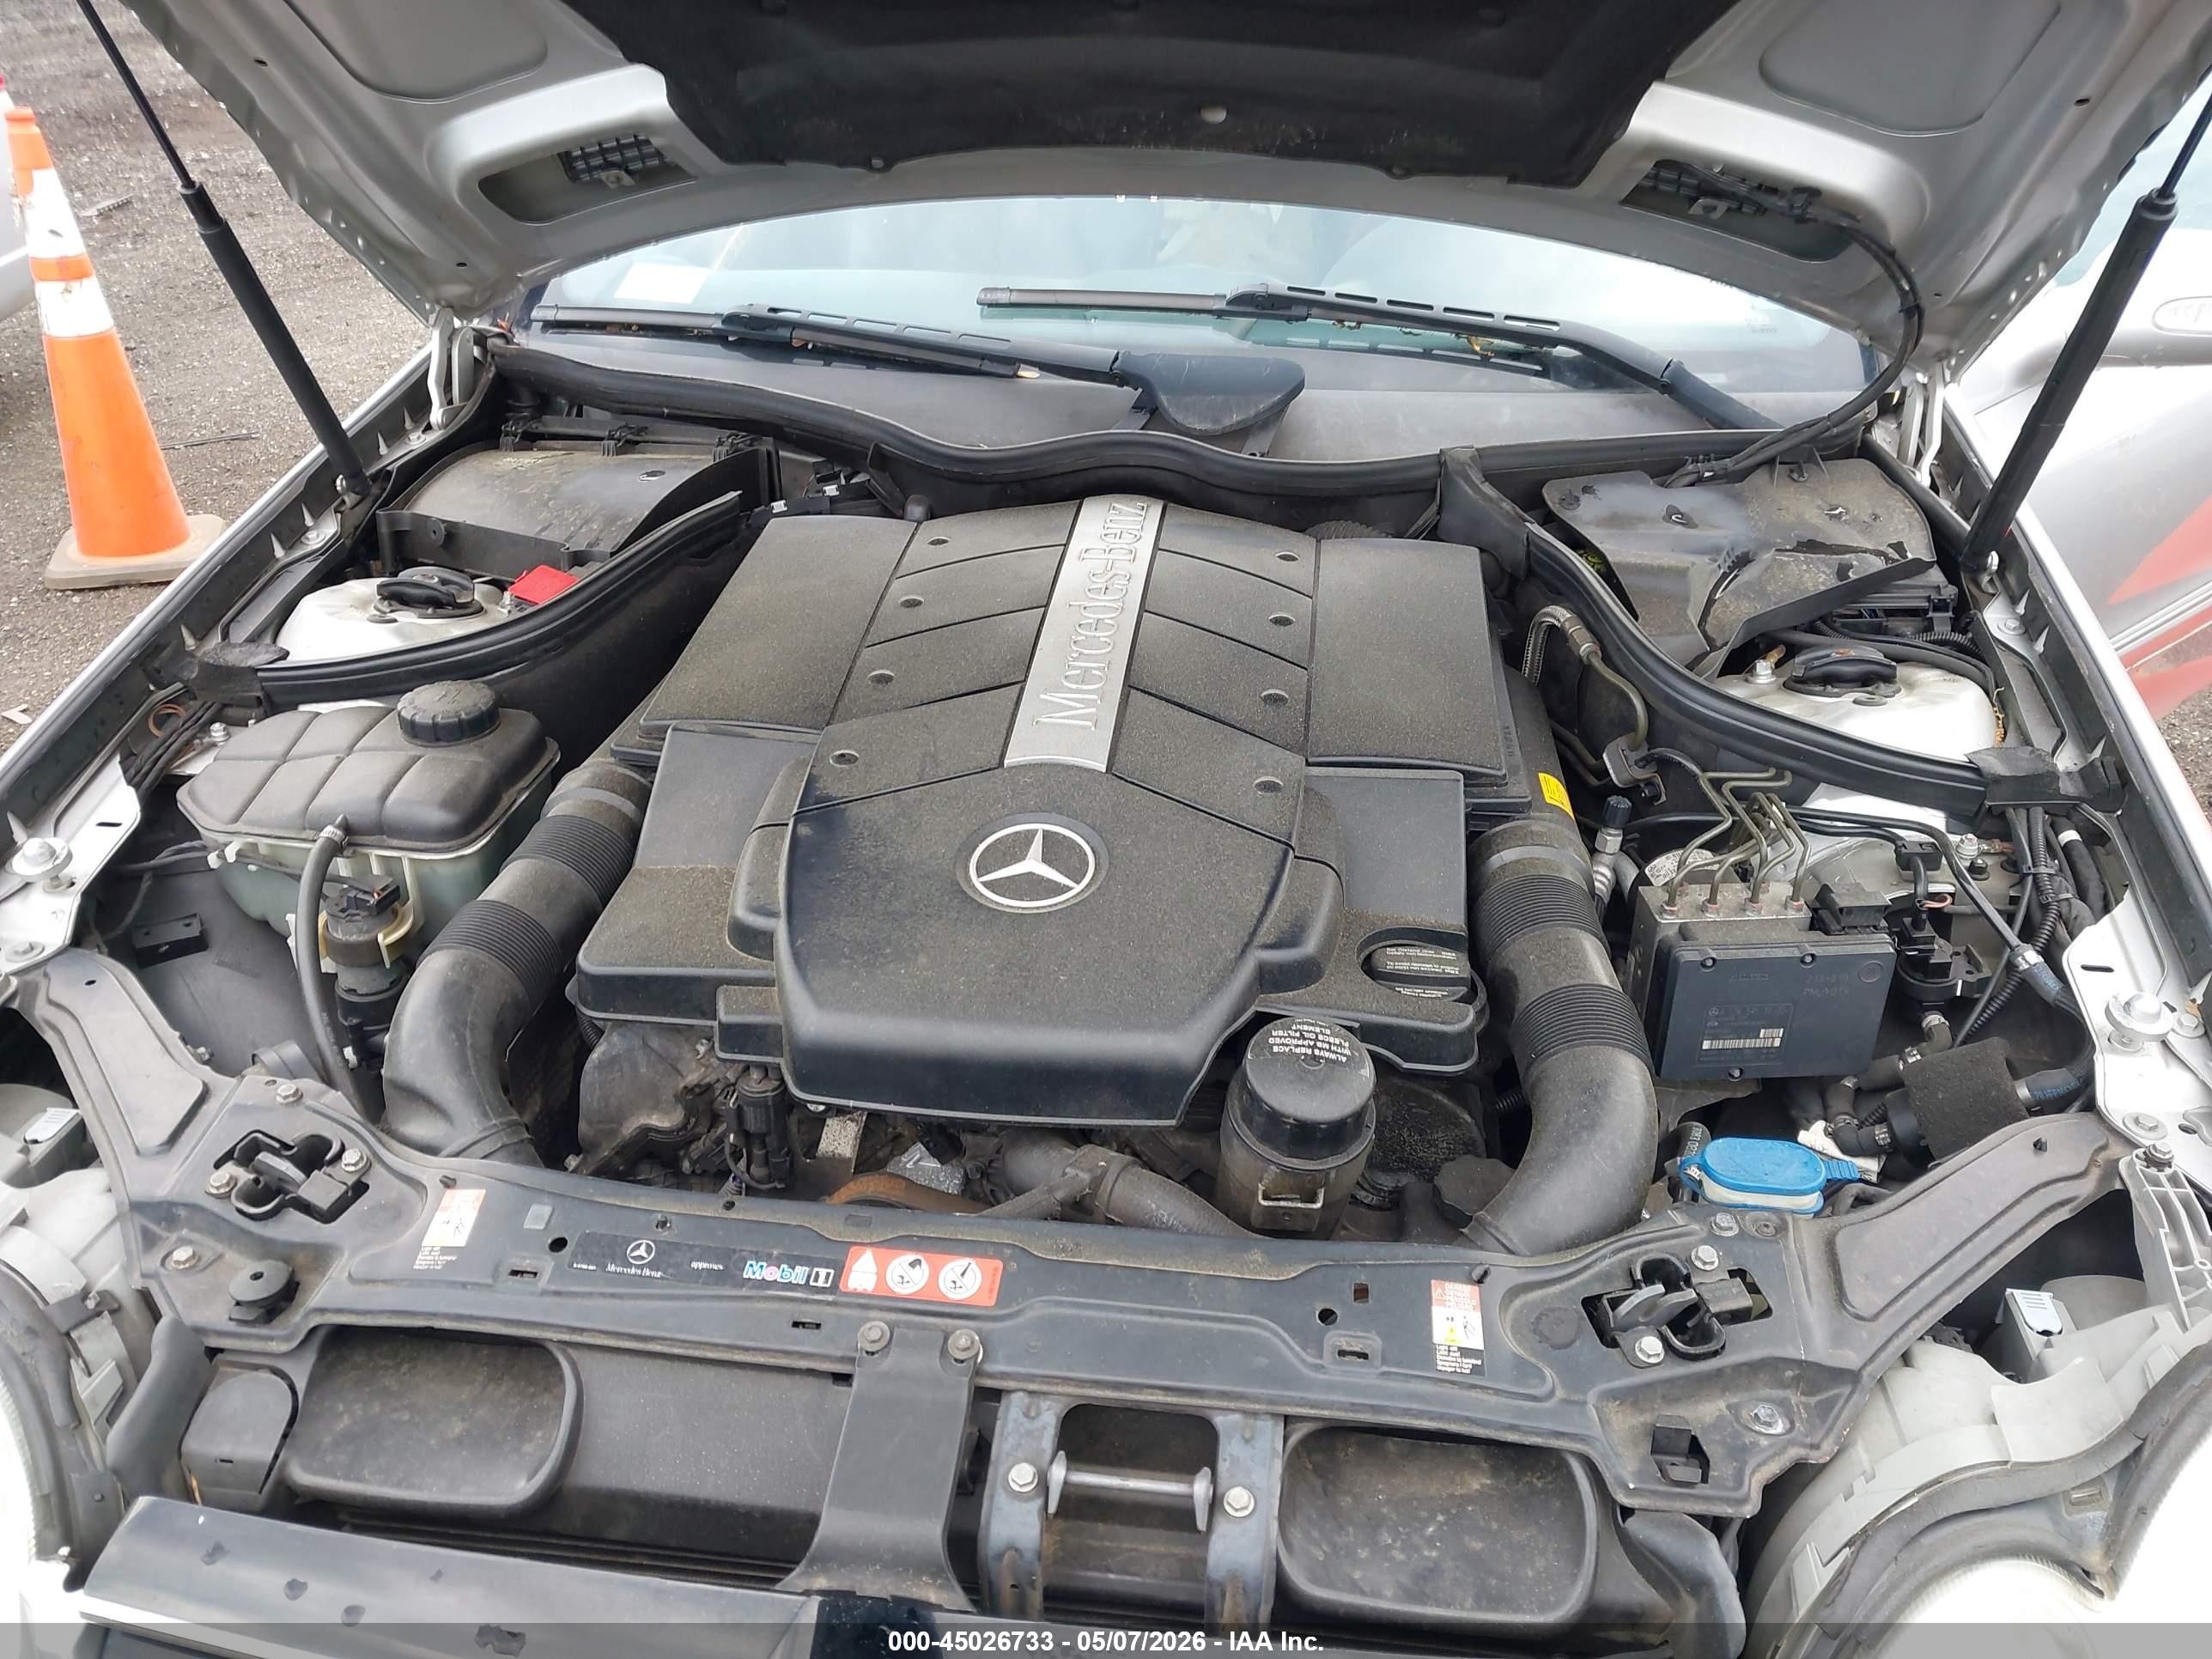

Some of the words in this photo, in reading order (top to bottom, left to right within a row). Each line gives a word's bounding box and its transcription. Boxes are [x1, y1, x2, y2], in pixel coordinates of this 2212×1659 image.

[1032, 501, 1147, 731] Mercedes-Benz
[1291, 1024, 1331, 1035] ELEMENT
[1268, 1037, 1315, 1047] APPROVED
[1273, 1045, 1312, 1055] REPLACE
[1314, 1048, 1347, 1063] ALWAYS
[1331, 1043, 1352, 1056] WITH
[743, 1260, 809, 1285] Mobil
